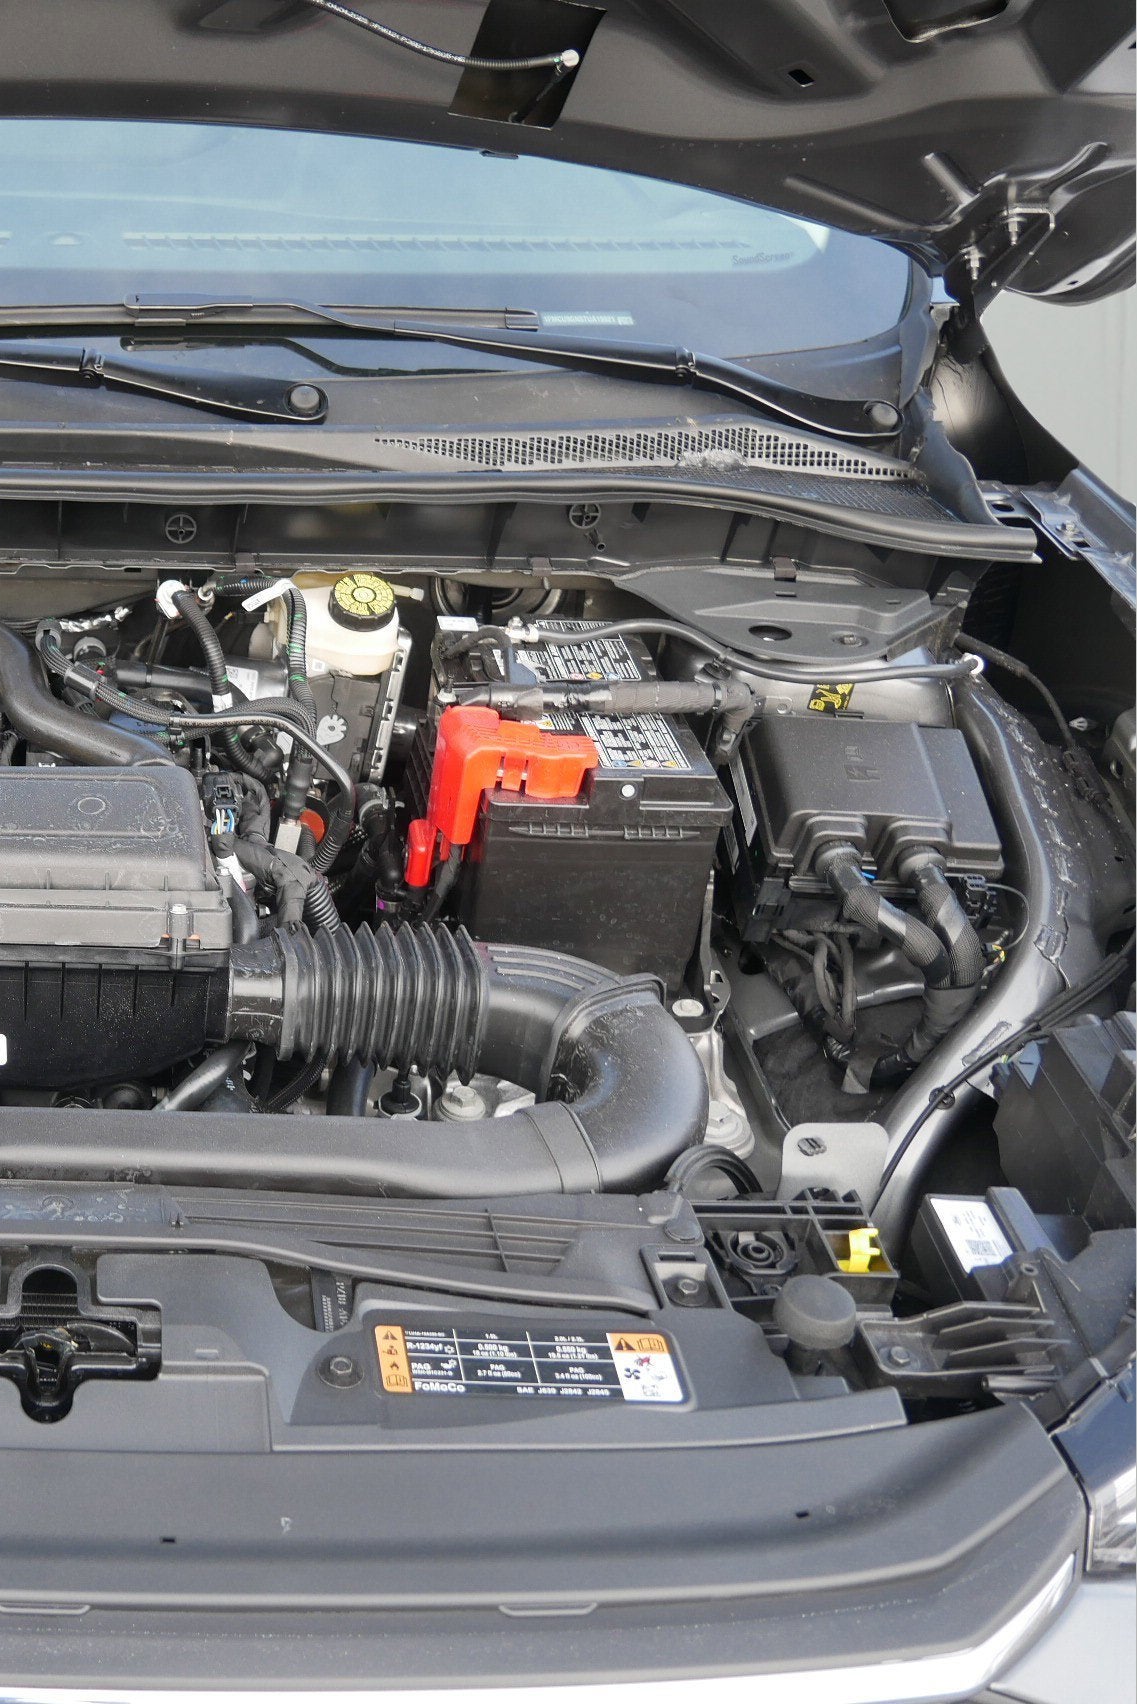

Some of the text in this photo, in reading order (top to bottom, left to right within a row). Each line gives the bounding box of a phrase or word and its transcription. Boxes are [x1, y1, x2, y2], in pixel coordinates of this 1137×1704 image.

[406, 1341, 444, 1353] R-1234yf
[411, 1362, 432, 1371] PAG
[489, 1363, 506, 1371] PAG
[568, 1366, 585, 1374] PAG
[414, 1381, 466, 1393] FoMoCo
